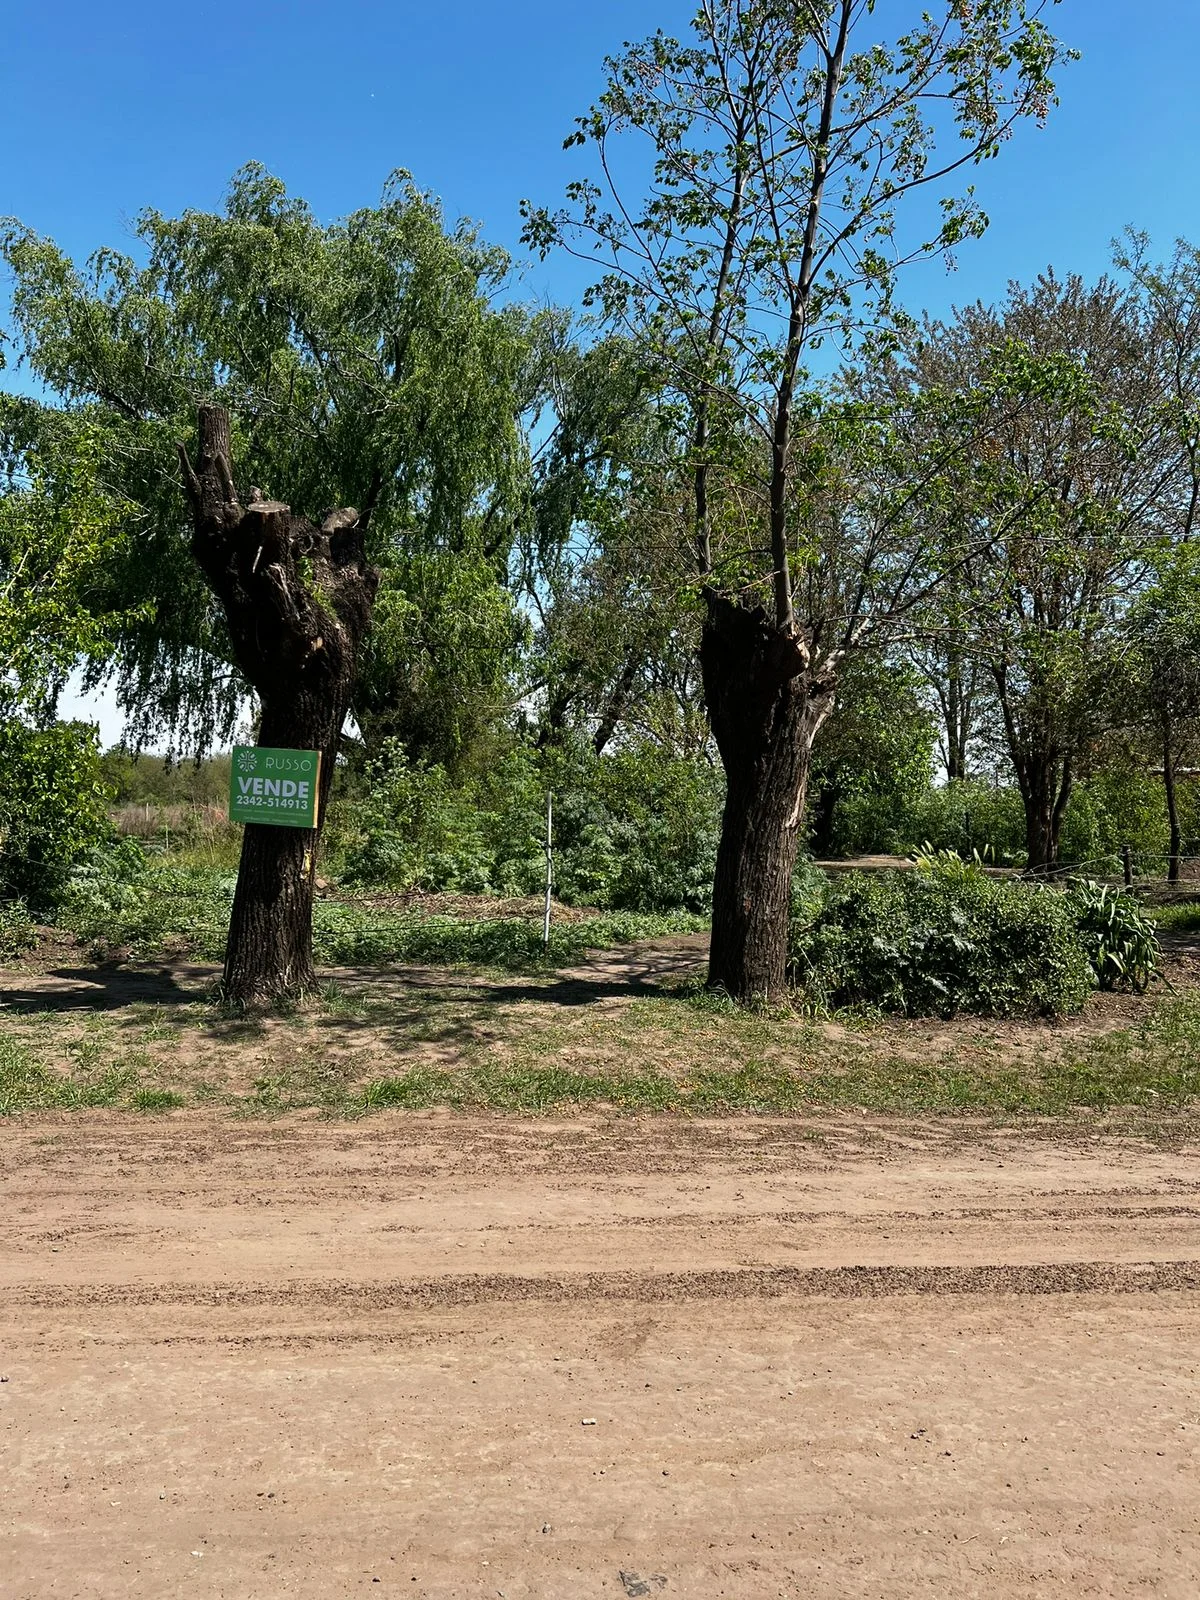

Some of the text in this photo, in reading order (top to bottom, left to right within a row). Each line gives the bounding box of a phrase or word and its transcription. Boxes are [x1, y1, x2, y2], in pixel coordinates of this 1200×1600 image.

[265, 757, 312, 771] RUSSO
[237, 776, 309, 799] VENDE
[236, 795, 308, 810] 2342-514913
